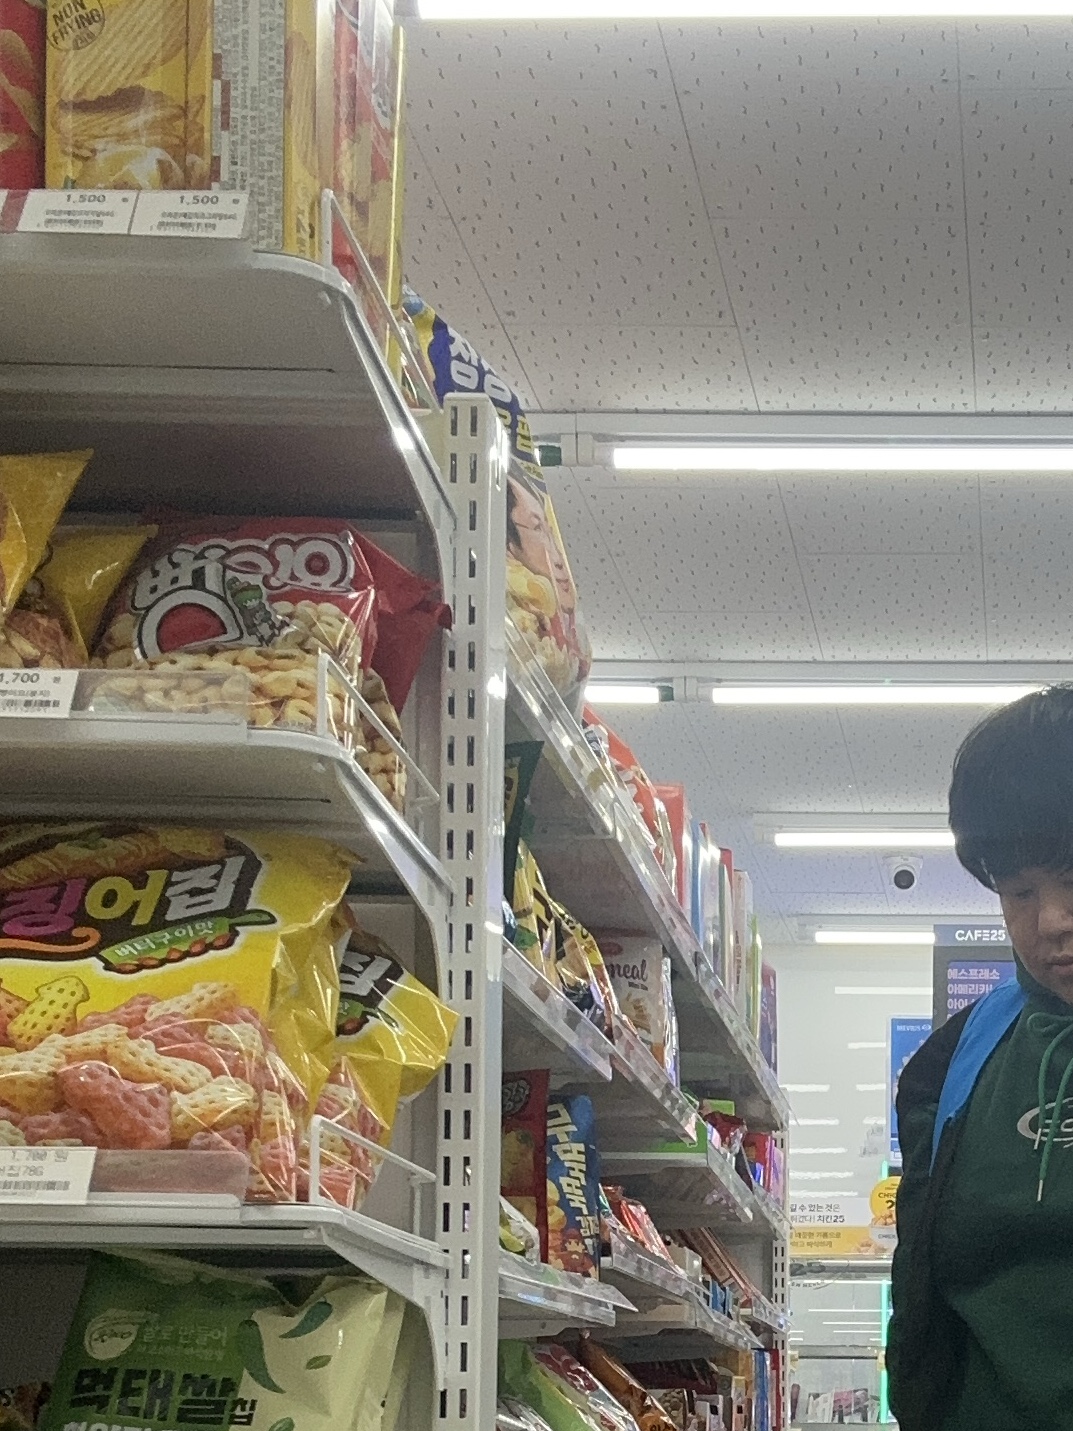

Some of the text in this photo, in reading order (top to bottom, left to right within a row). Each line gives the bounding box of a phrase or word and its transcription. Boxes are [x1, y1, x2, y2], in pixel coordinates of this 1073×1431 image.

[66, 194, 106, 204] 1,500
[179, 195, 219, 205] 1,500
[0, 855, 246, 937] 징어집
[114, 919, 215, 958] 버터구이맛
[955, 930, 1006, 941] CAFE25
[947, 968, 1000, 980] 에스프레소
[947, 984, 993, 995] 아메리카
[818, 1214, 845, 1224] 치킨25
